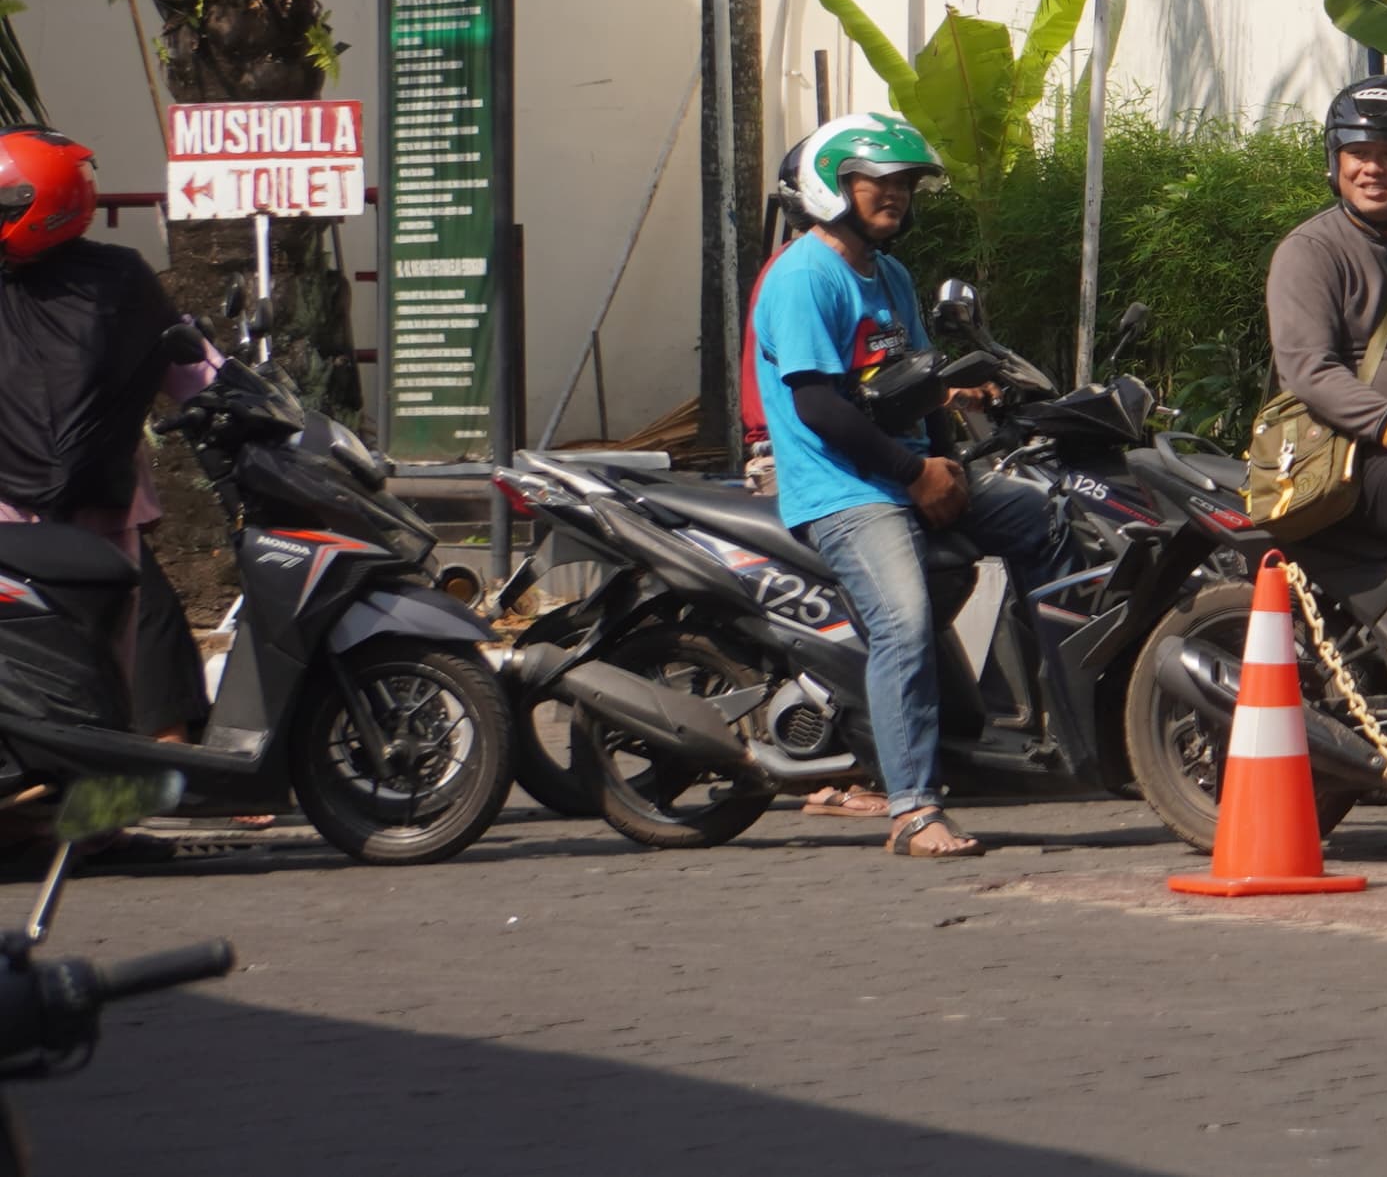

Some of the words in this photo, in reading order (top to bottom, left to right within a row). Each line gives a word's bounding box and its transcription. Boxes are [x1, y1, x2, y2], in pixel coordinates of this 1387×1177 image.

[174, 106, 357, 156] MUSHOLLA
[228, 165, 356, 211] TOILET
[1071, 474, 1110, 501] 125
[256, 534, 312, 556] HONDA
[756, 566, 837, 625] 125
